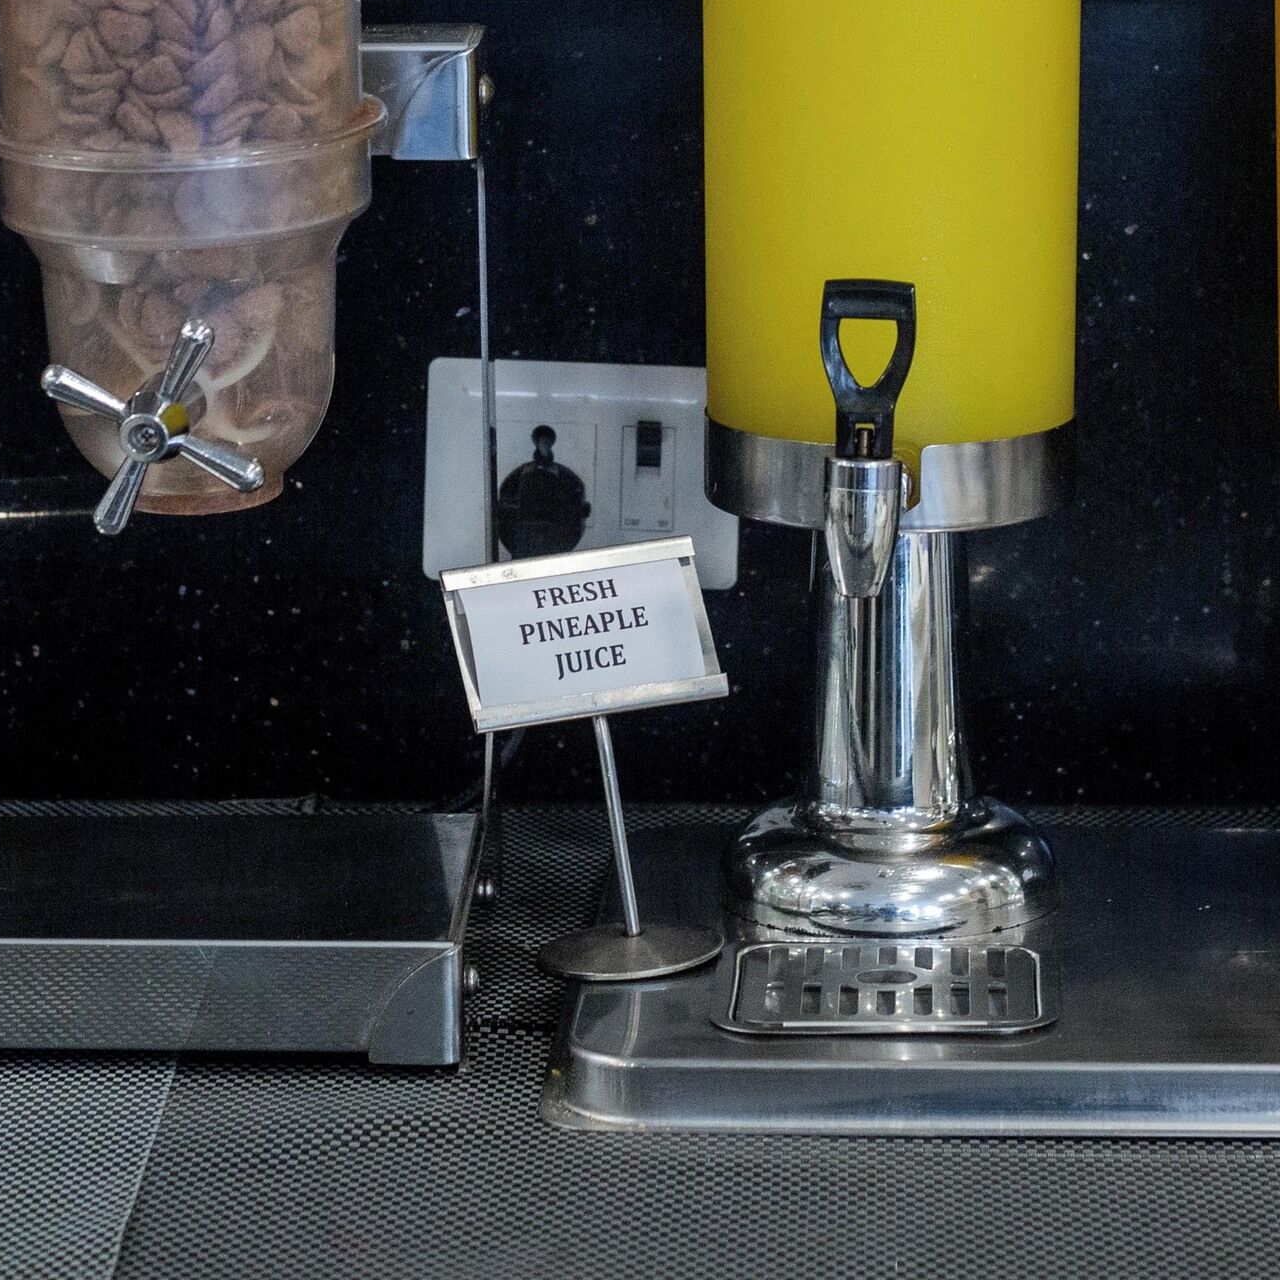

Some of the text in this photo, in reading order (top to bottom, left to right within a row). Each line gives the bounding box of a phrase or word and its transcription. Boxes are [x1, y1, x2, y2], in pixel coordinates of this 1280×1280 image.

[532, 578, 619, 609] FRESH
[519, 606, 649, 645] PINEAPLE
[554, 644, 627, 680] JUICE
